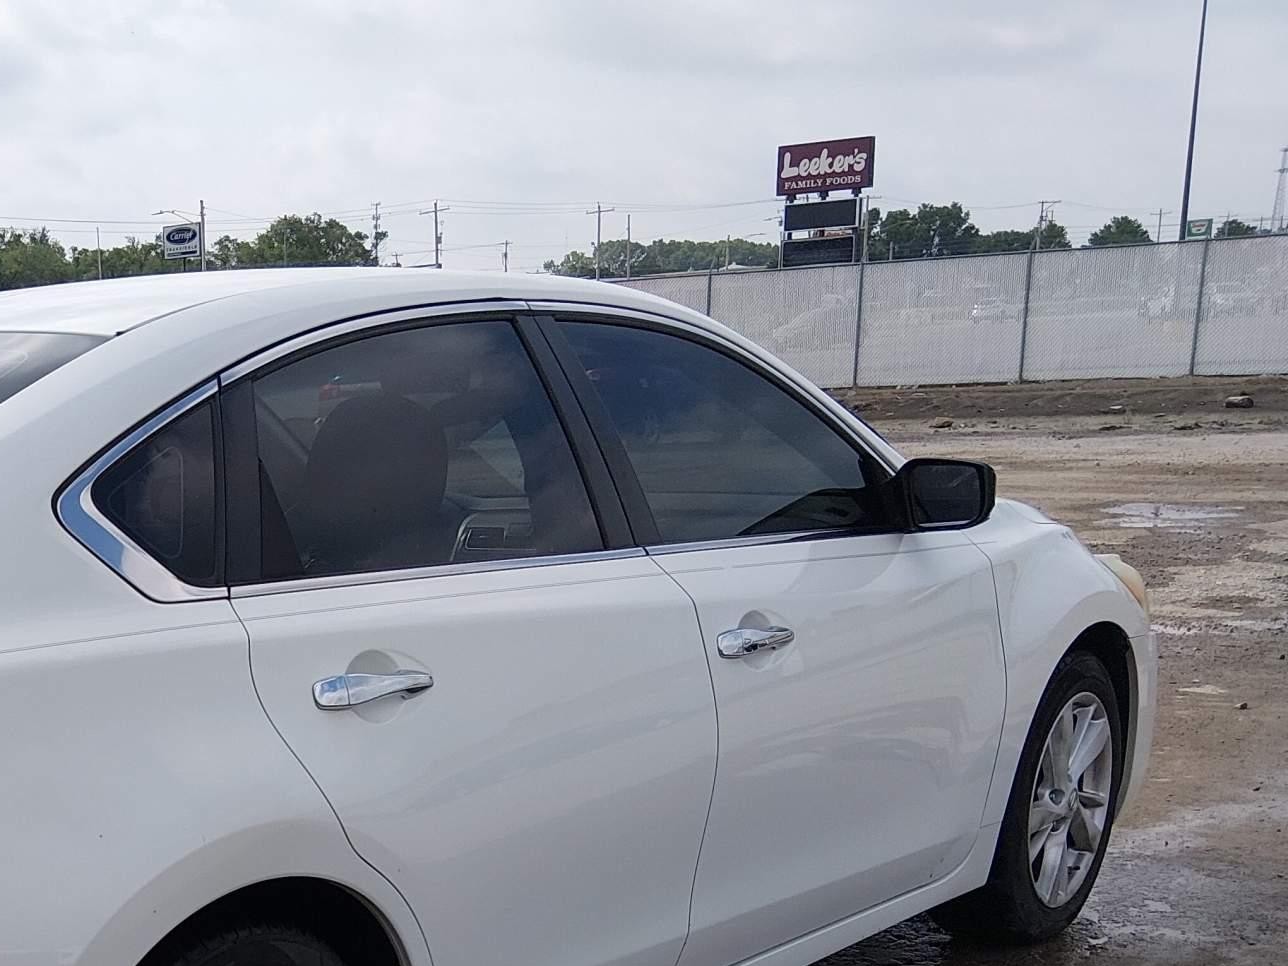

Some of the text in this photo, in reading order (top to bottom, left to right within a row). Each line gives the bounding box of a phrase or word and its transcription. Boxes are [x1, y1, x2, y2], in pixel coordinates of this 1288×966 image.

[781, 148, 867, 178] Leeker's
[784, 175, 861, 189] FAMILY FOODS
